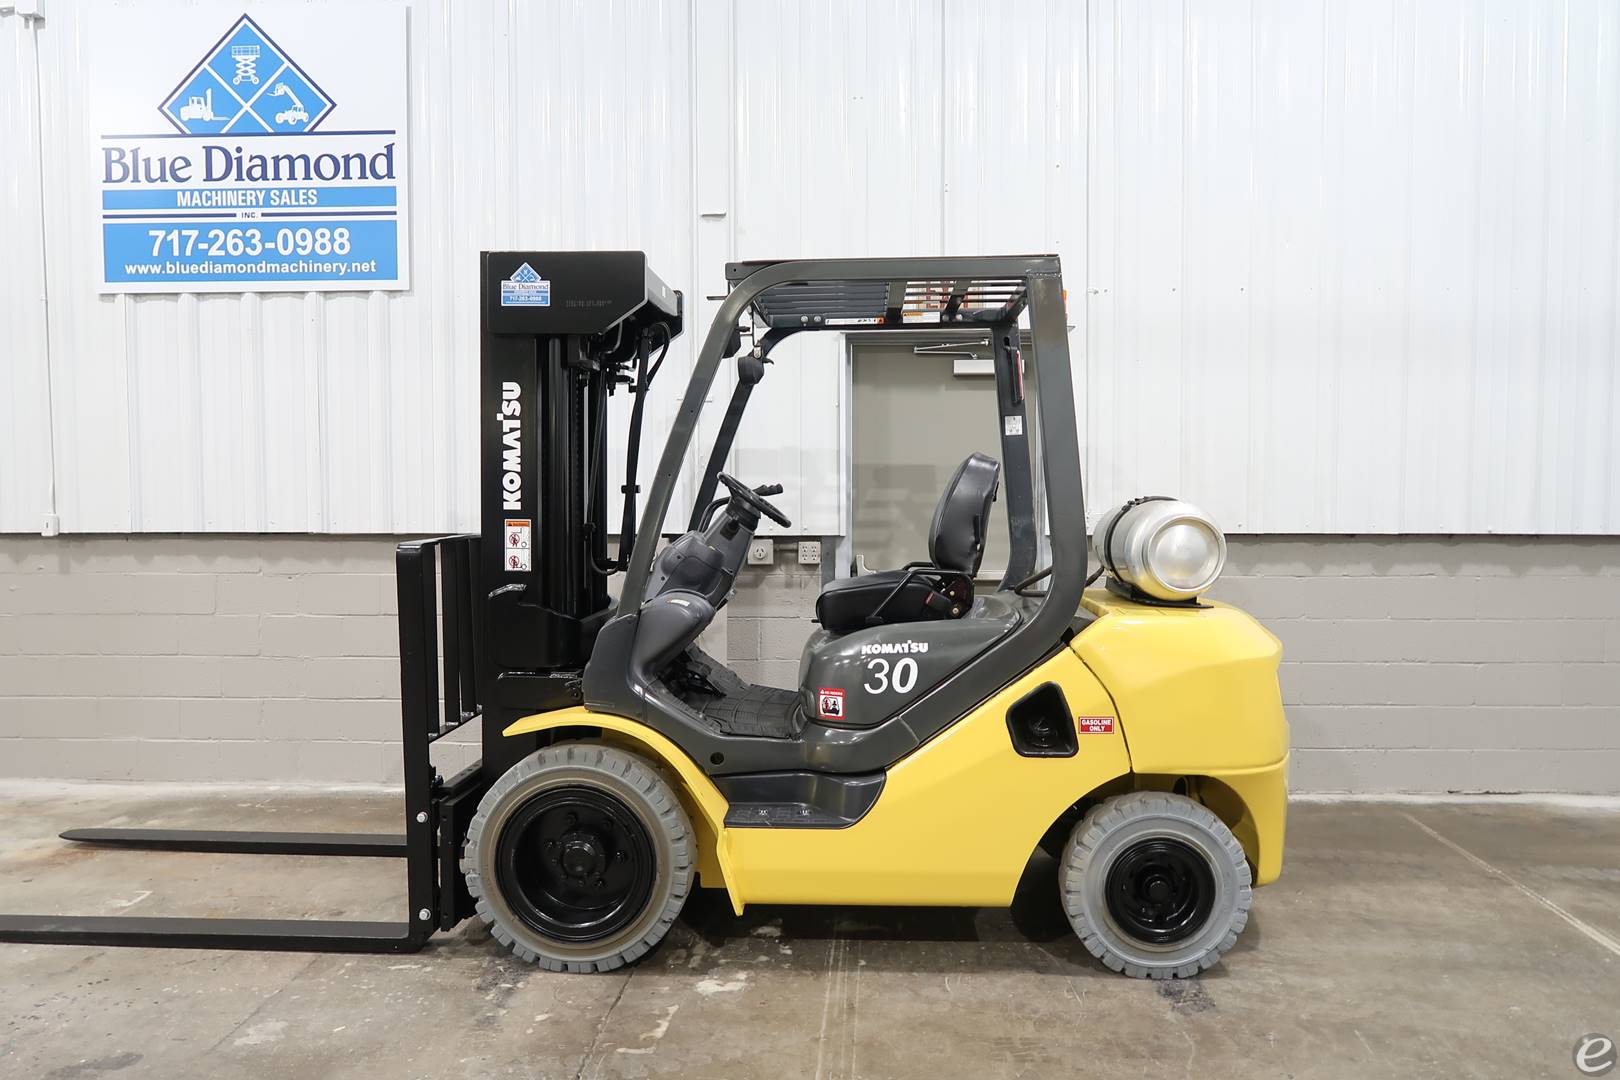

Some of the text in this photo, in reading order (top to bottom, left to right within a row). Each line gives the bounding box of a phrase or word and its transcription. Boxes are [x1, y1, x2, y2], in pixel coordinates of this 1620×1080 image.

[102, 142, 396, 184] Blue Diamond
[176, 189, 317, 207] MACHINERY SALES
[148, 227, 351, 257] 717-263-0988
[125, 260, 377, 276] www.bluediamondmachinery.net
[497, 381, 521, 510] KOMATSU
[861, 640, 929, 655] KOMATSU
[864, 657, 919, 694] 30
